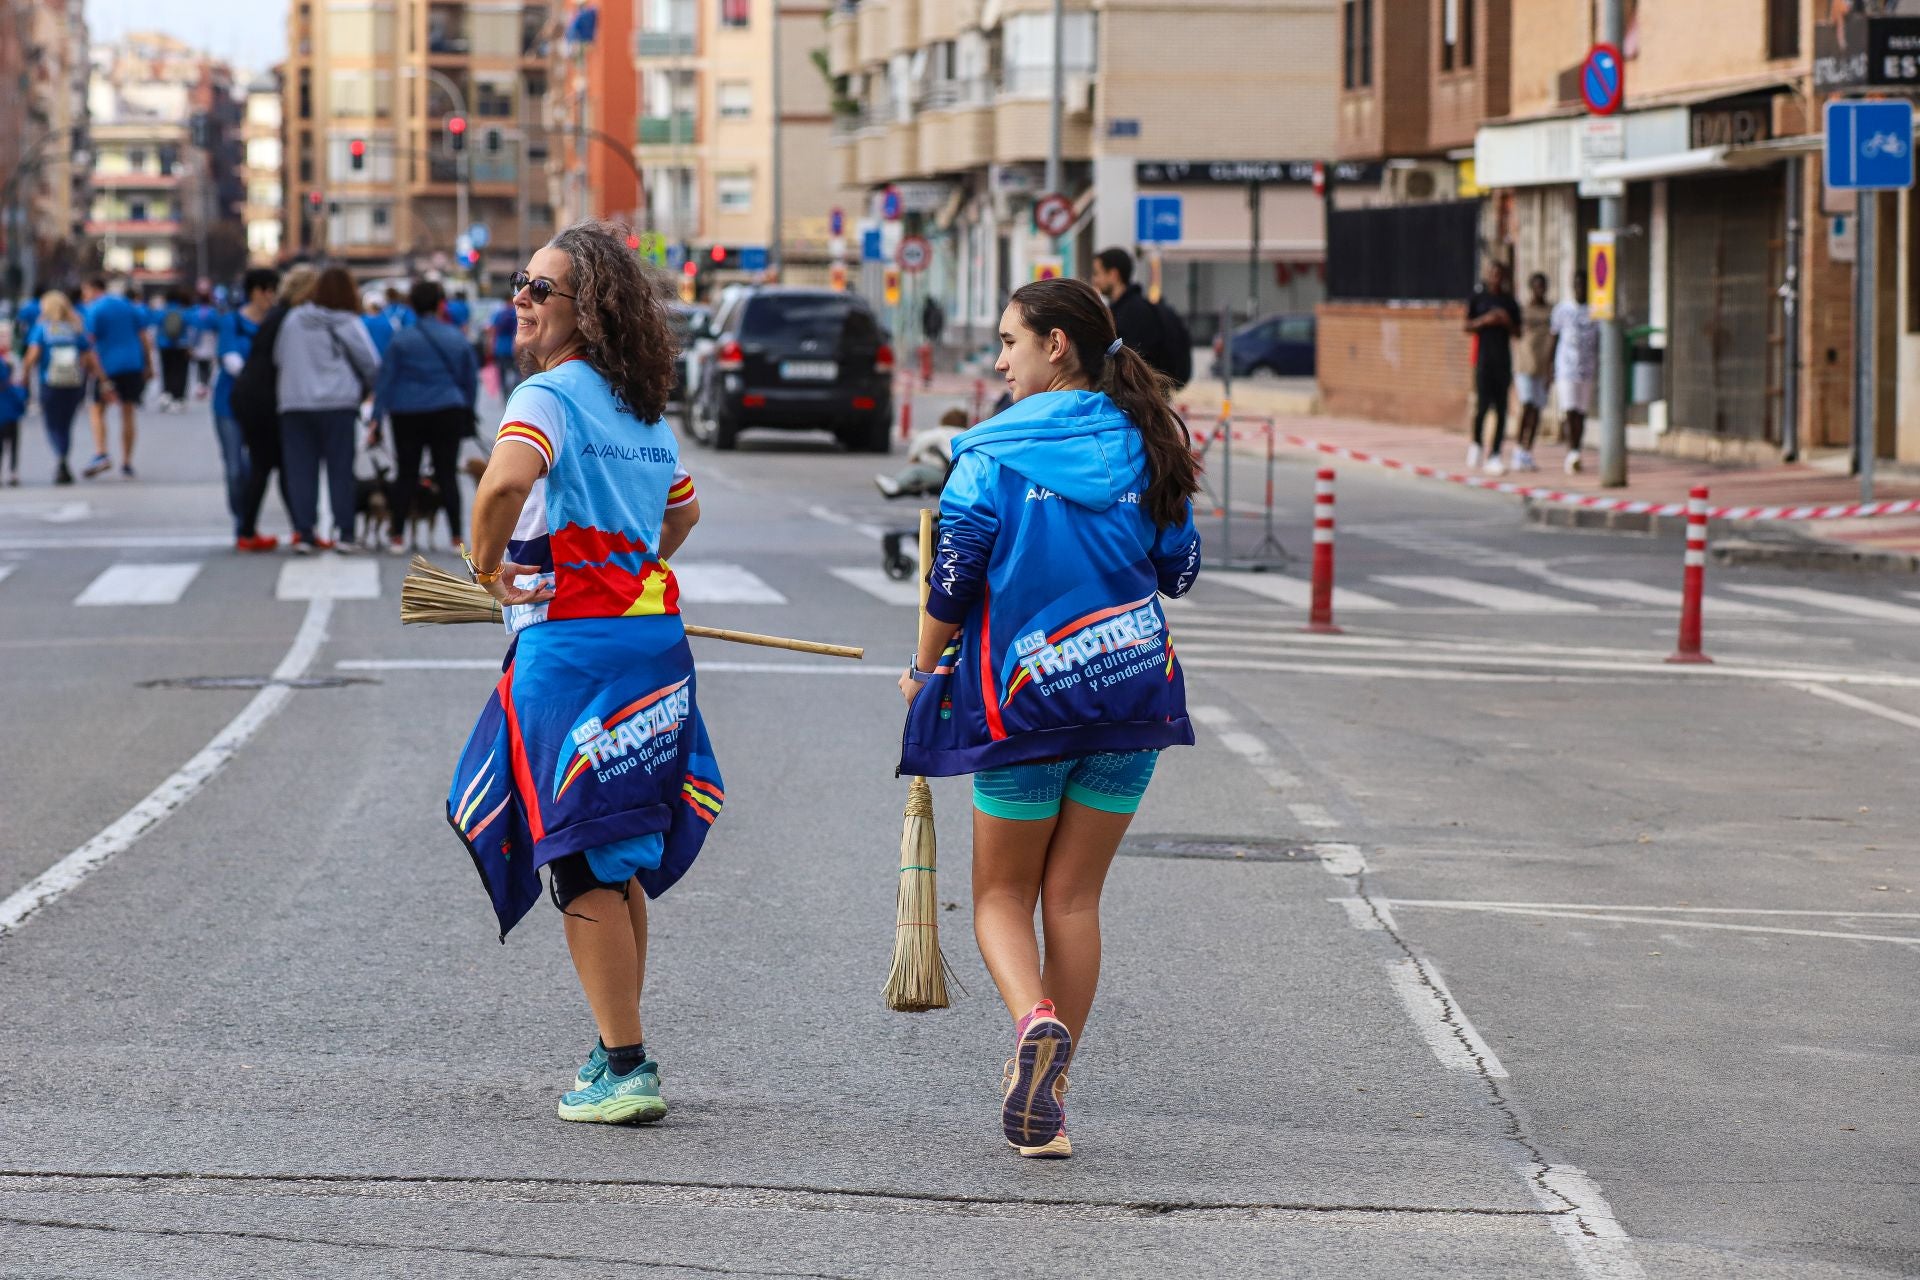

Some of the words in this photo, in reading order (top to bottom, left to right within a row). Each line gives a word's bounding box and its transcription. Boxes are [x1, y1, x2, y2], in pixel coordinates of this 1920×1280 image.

[1884, 55, 1920, 79] ES
[1014, 629, 1048, 656] LOS
[1039, 672, 1082, 697] Grupo
[1086, 664, 1103, 678] de
[1103, 652, 1166, 688] Senderismo
[571, 716, 604, 746] LOS
[597, 756, 637, 783] Grupo
[639, 747, 654, 762] de
